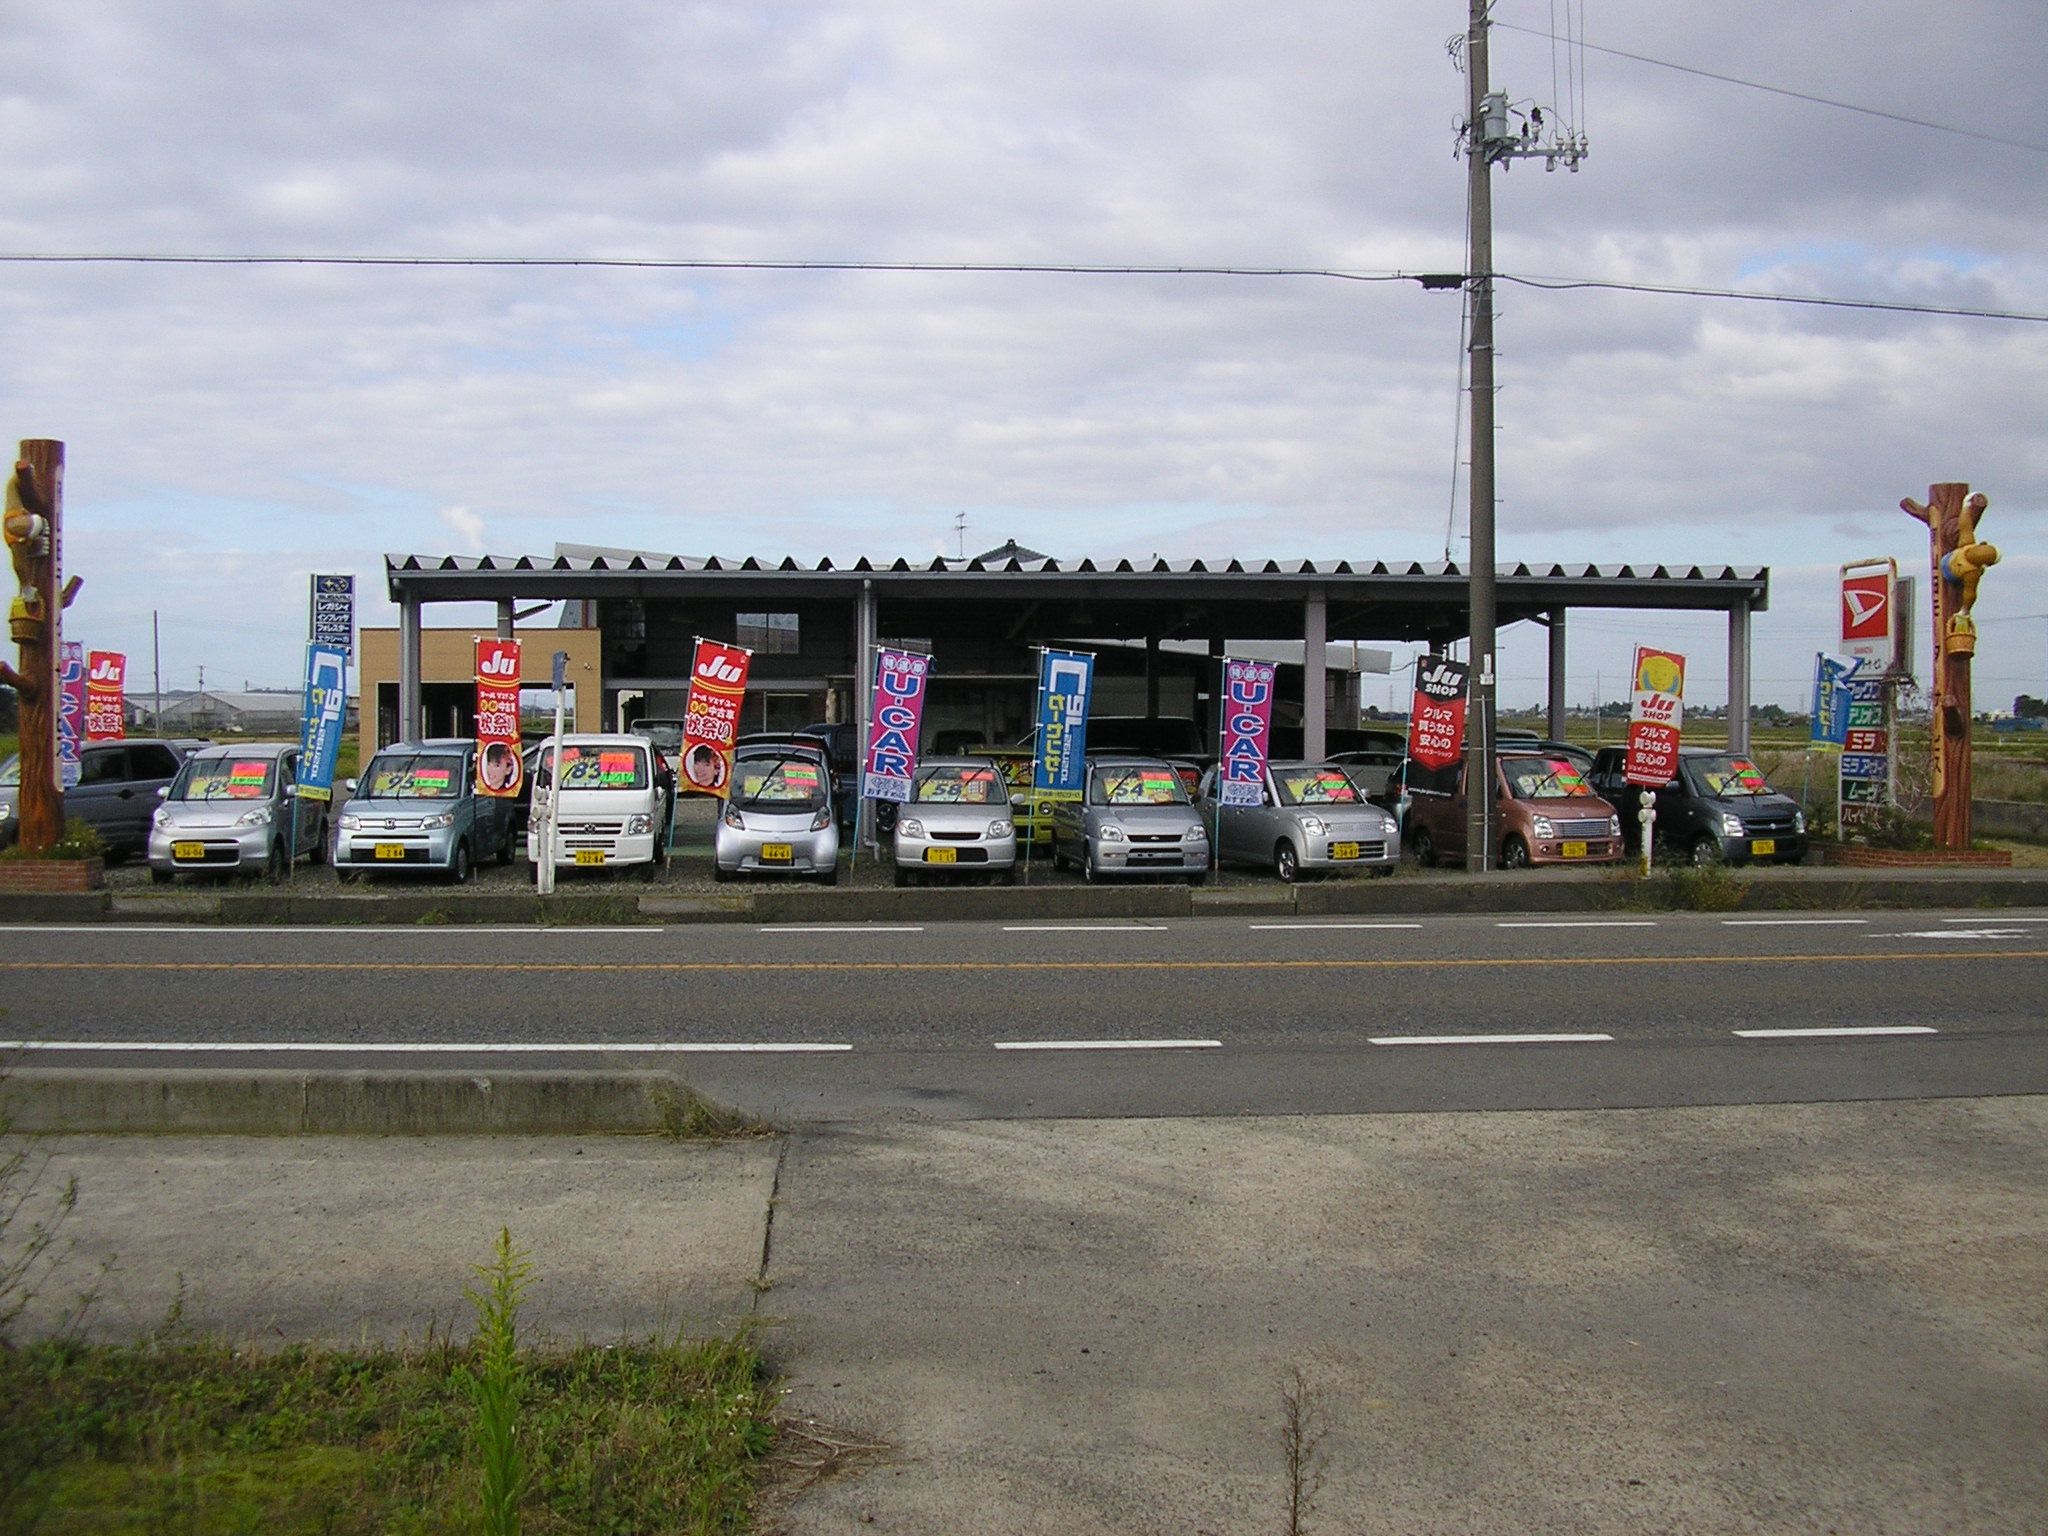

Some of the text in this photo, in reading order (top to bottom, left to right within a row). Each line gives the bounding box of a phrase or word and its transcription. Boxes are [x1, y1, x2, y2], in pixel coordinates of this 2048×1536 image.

[698, 656, 743, 683] Ju
[1422, 664, 1463, 686] Ju
[1424, 683, 1458, 697] SHOP
[1423, 706, 1453, 722] クルマ
[1643, 710, 1672, 720] SHOP
[1418, 720, 1455, 736] 買うなら
[1641, 726, 1670, 739] クルマ
[1419, 734, 1451, 749] 安心の
[1634, 737, 1672, 753] 買うなら
[1851, 733, 1876, 750] ミラ
[1635, 752, 1667, 766] 安心の
